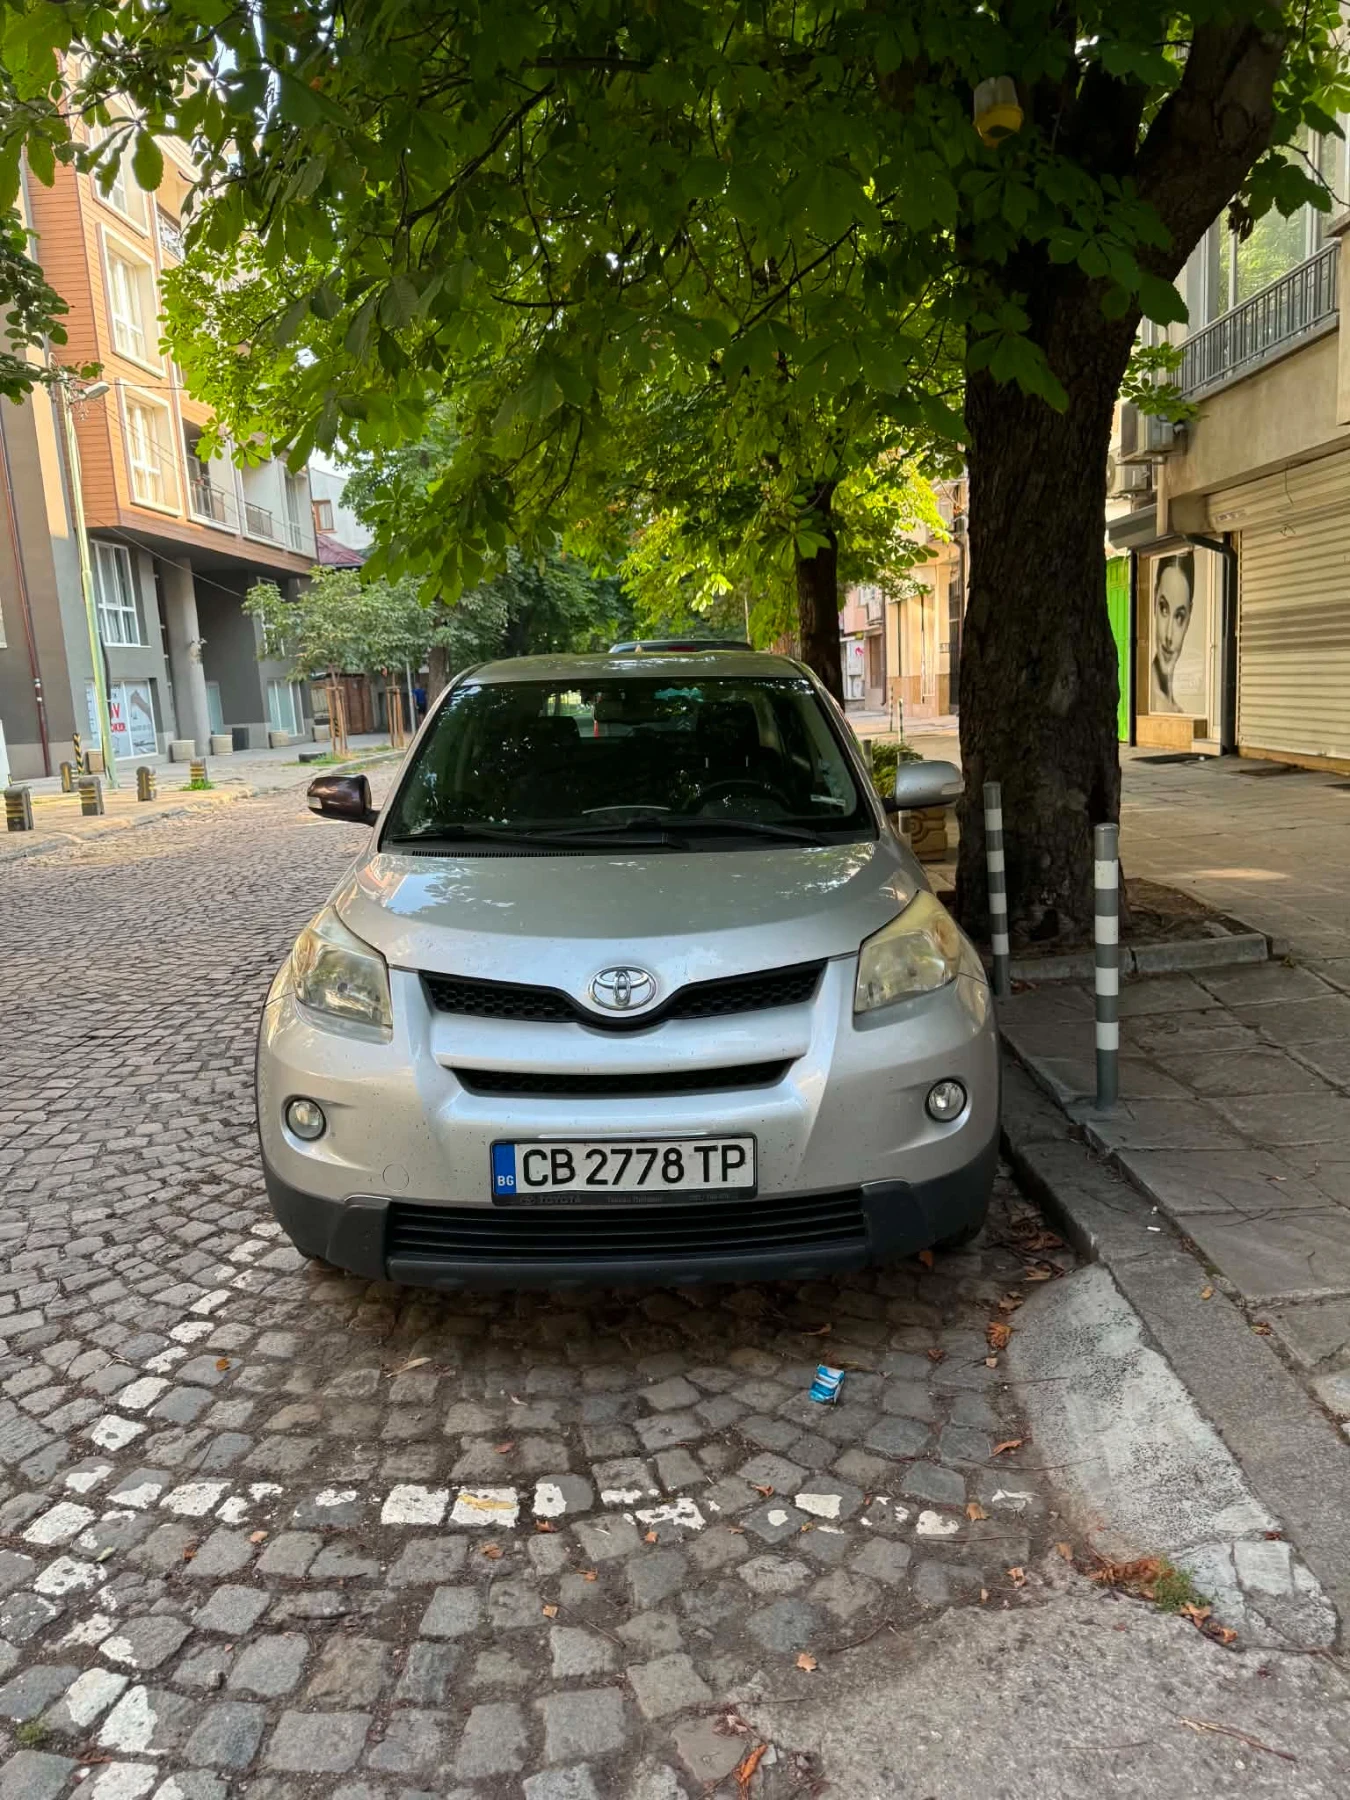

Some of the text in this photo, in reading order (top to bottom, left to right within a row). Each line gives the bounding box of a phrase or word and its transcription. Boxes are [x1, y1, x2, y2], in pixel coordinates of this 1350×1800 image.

[522, 1144, 747, 1187] CB 2778 TP
[497, 1175, 514, 1187] BG
